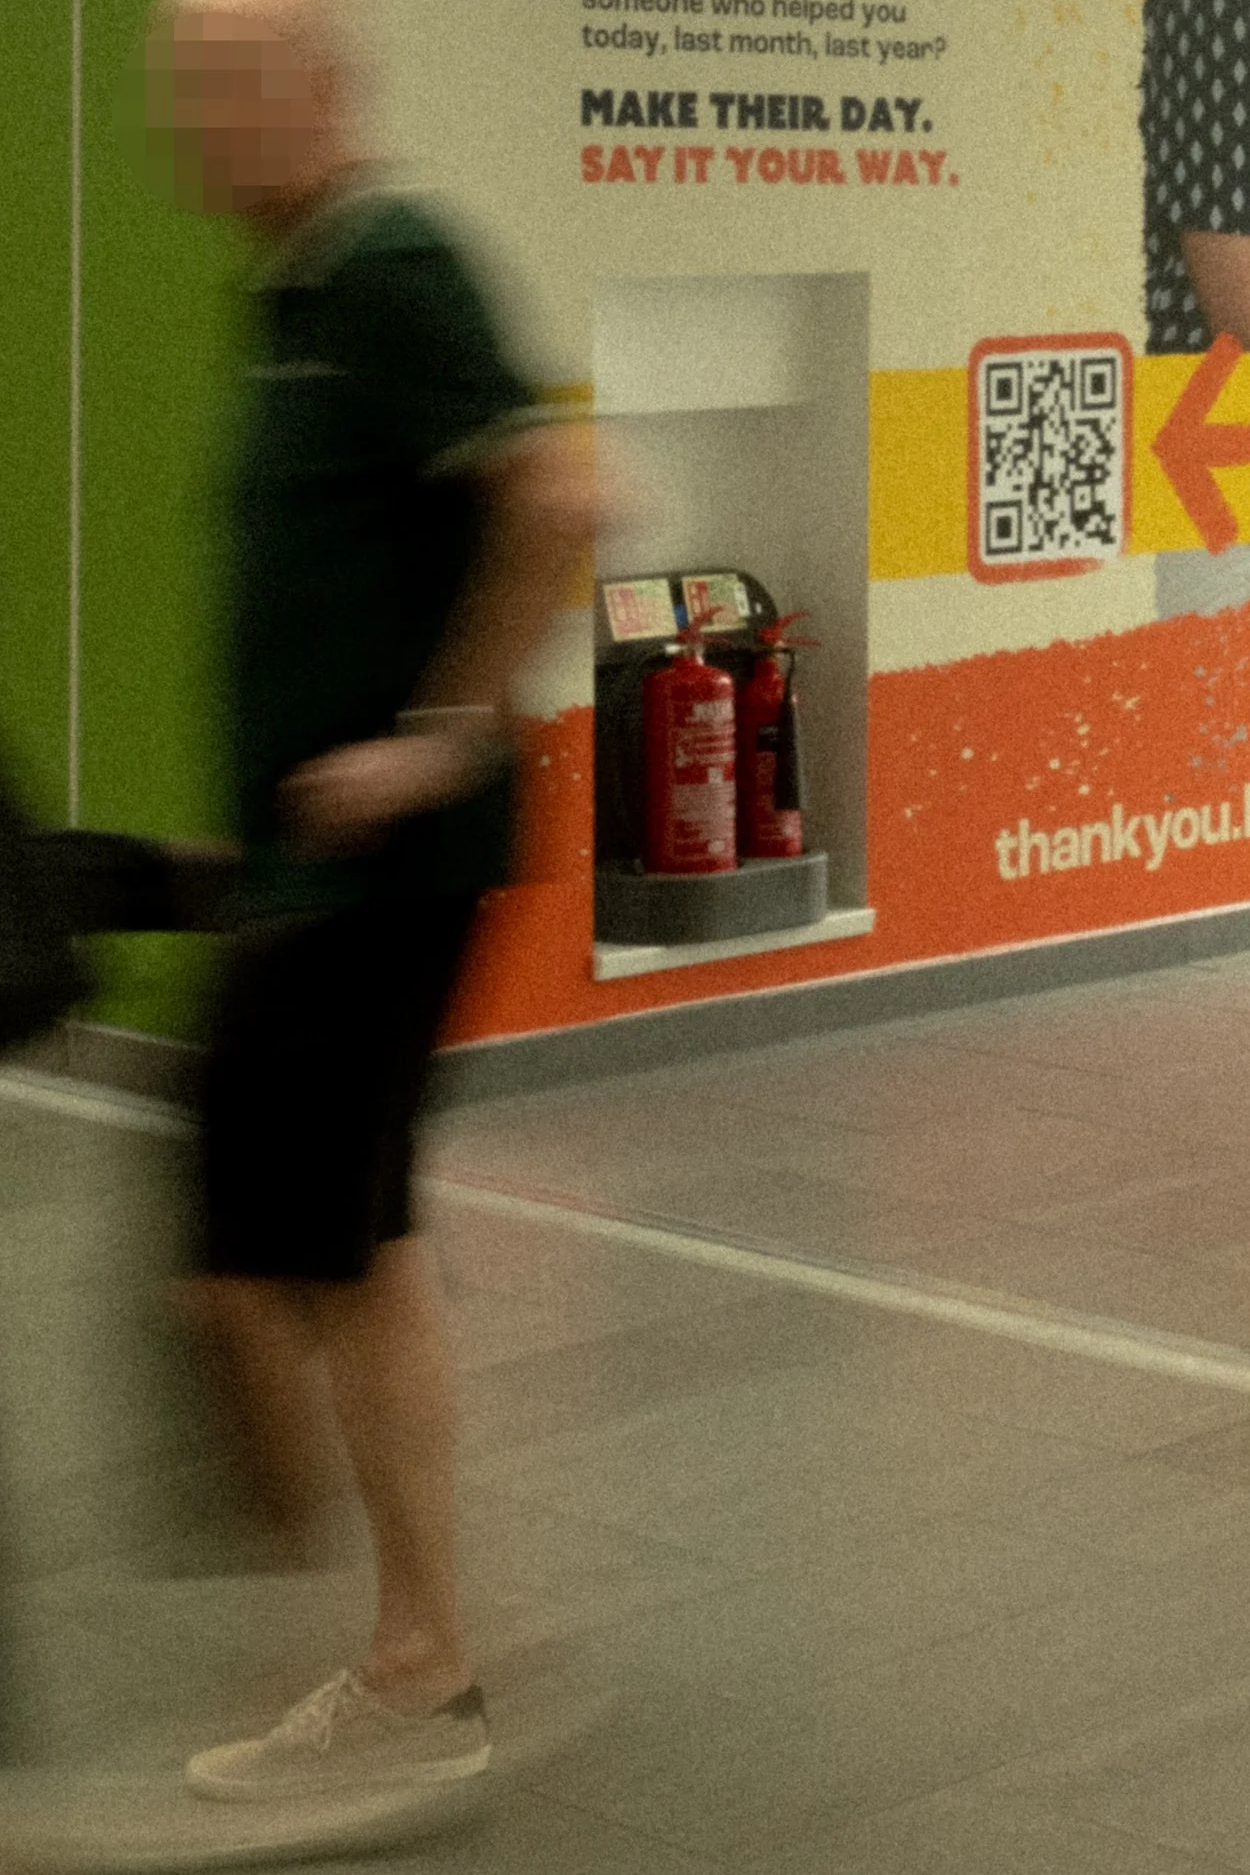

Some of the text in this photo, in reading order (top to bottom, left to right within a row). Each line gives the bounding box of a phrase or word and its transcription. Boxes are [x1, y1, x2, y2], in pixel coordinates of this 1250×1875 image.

[862, 4, 906, 27] you
[582, 24, 946, 65] today, last month, last year?
[581, 88, 934, 133] MAKE THEIR DAY.
[580, 144, 960, 187] SAY IT YOUR WAY.
